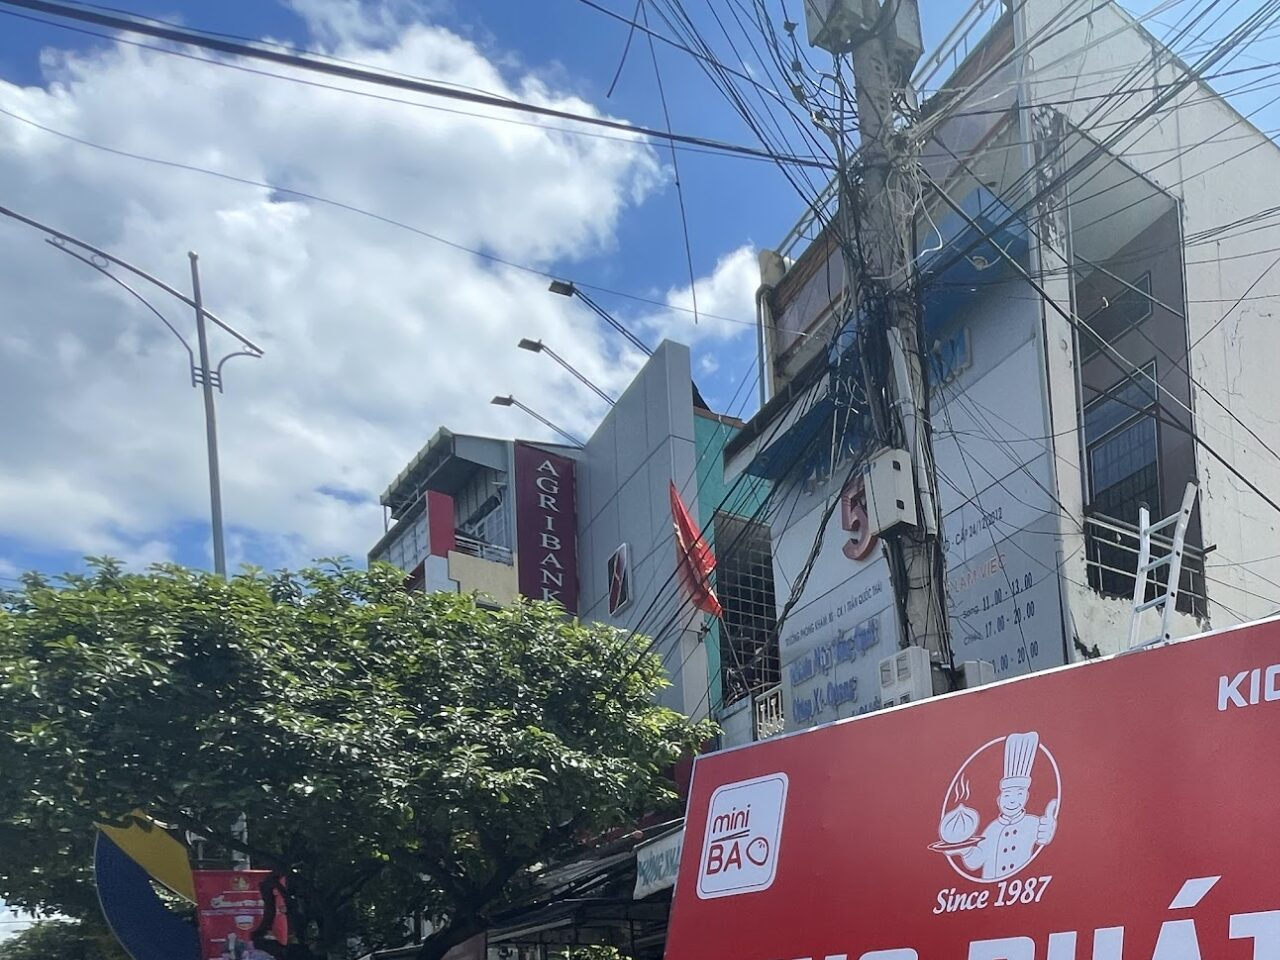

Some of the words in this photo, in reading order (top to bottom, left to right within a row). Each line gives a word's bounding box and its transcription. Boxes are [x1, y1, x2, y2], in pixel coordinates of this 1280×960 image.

[536, 459, 564, 604] AGRIBANK
[712, 803, 751, 834] mini
[932, 887, 990, 914] Since
[994, 875, 1053, 907] 1987
